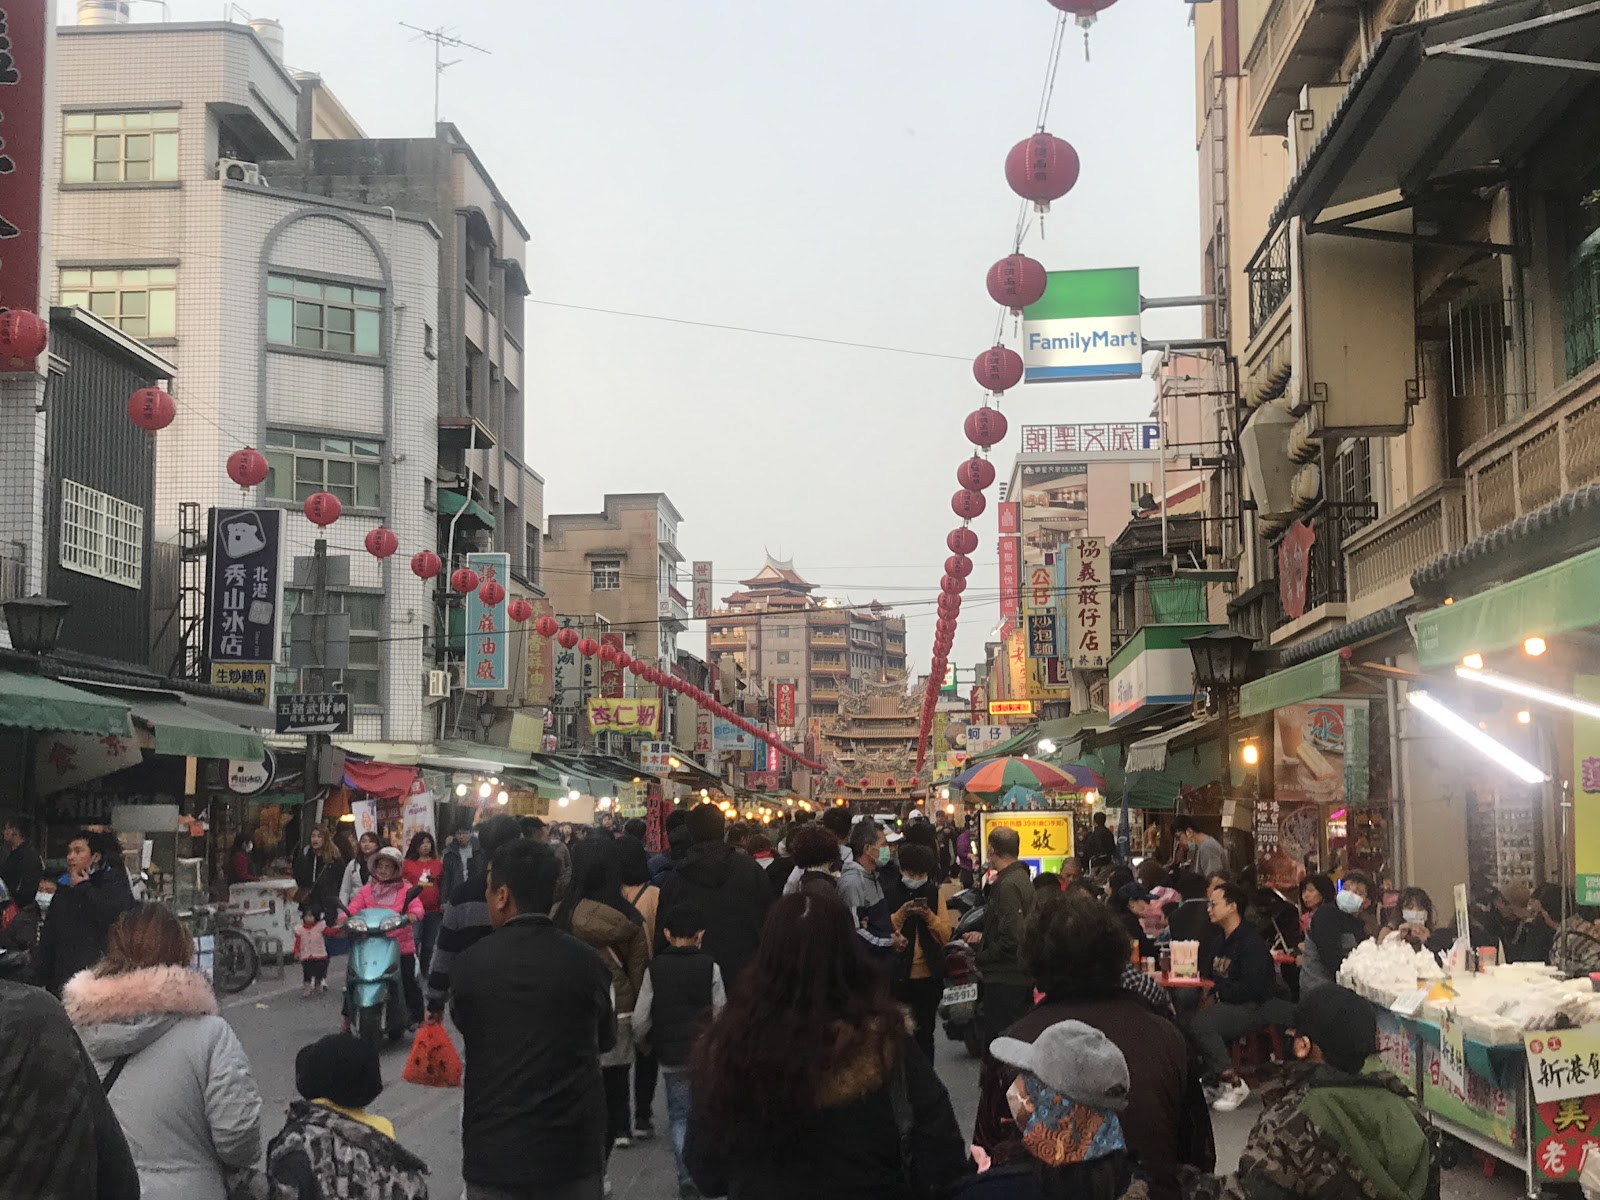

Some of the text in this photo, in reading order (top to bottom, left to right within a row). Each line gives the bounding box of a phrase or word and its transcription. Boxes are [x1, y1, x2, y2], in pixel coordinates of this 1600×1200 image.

[1029, 331, 1137, 353] FamilyMart
[1025, 425, 1135, 452] 朝聖文旅
[1143, 425, 1160, 449] P
[252, 566, 269, 598] 北港
[220, 563, 247, 657] 秀山冰店
[279, 702, 346, 715] 五路武財神
[591, 704, 656, 726] 杏仁粉
[1031, 828, 1056, 851] 敏
[1257, 834, 1279, 843] 2020
